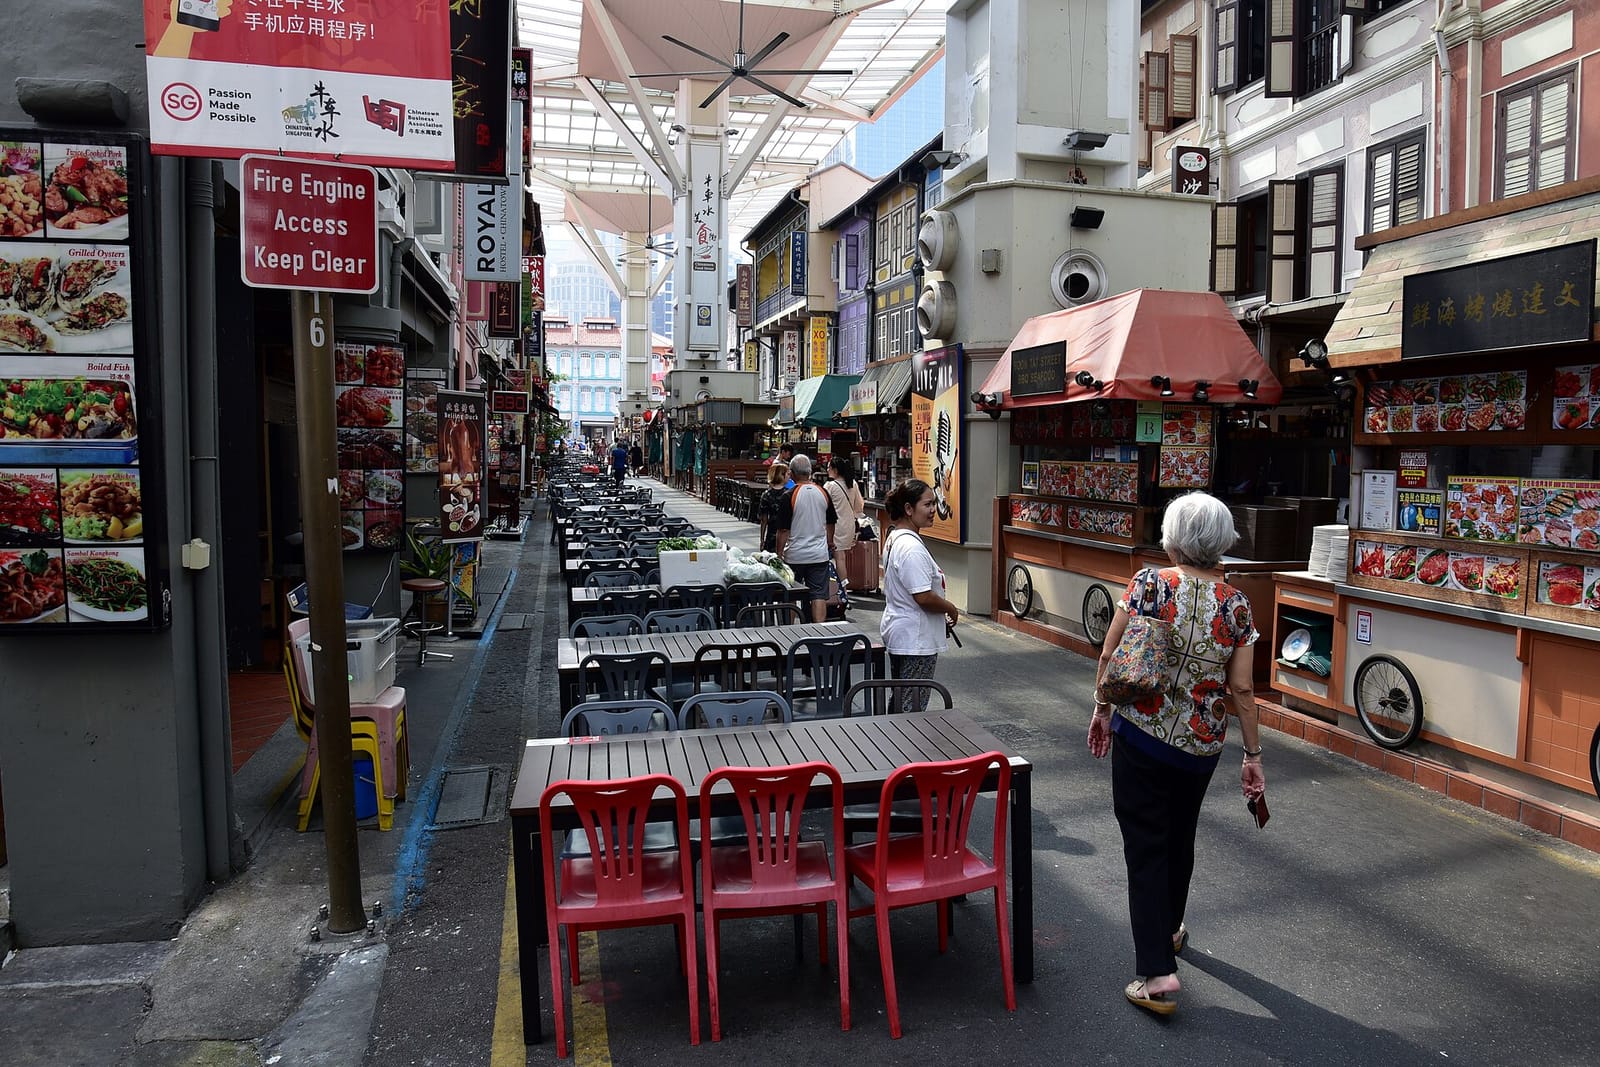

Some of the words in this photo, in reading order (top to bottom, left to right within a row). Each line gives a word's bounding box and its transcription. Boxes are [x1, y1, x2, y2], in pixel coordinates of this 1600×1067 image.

[208, 87, 252, 100] Passion
[167, 93, 198, 111] SG
[209, 99, 241, 111] Made
[209, 111, 257, 124] Possible
[407, 108, 440, 117] Chinatown
[285, 124, 313, 132] CHINATOWN
[408, 121, 443, 129] Association
[285, 130, 313, 138] SINGAPORE
[253, 168, 294, 195] Fire
[300, 172, 367, 205] Engine
[273, 208, 349, 237] Access
[477, 184, 496, 273] ROYAL
[68, 248, 96, 258] Grilled
[97, 249, 125, 260] Oysters
[253, 245, 305, 276] Keep
[310, 248, 368, 275] Clear
[499, 242, 507, 273] HOSTEL
[813, 330, 826, 340] XO
[87, 362, 112, 372] Boiled
[113, 363, 131, 371] Fish
[916, 368, 933, 392] LIVE
[1144, 421, 1154, 435] B
